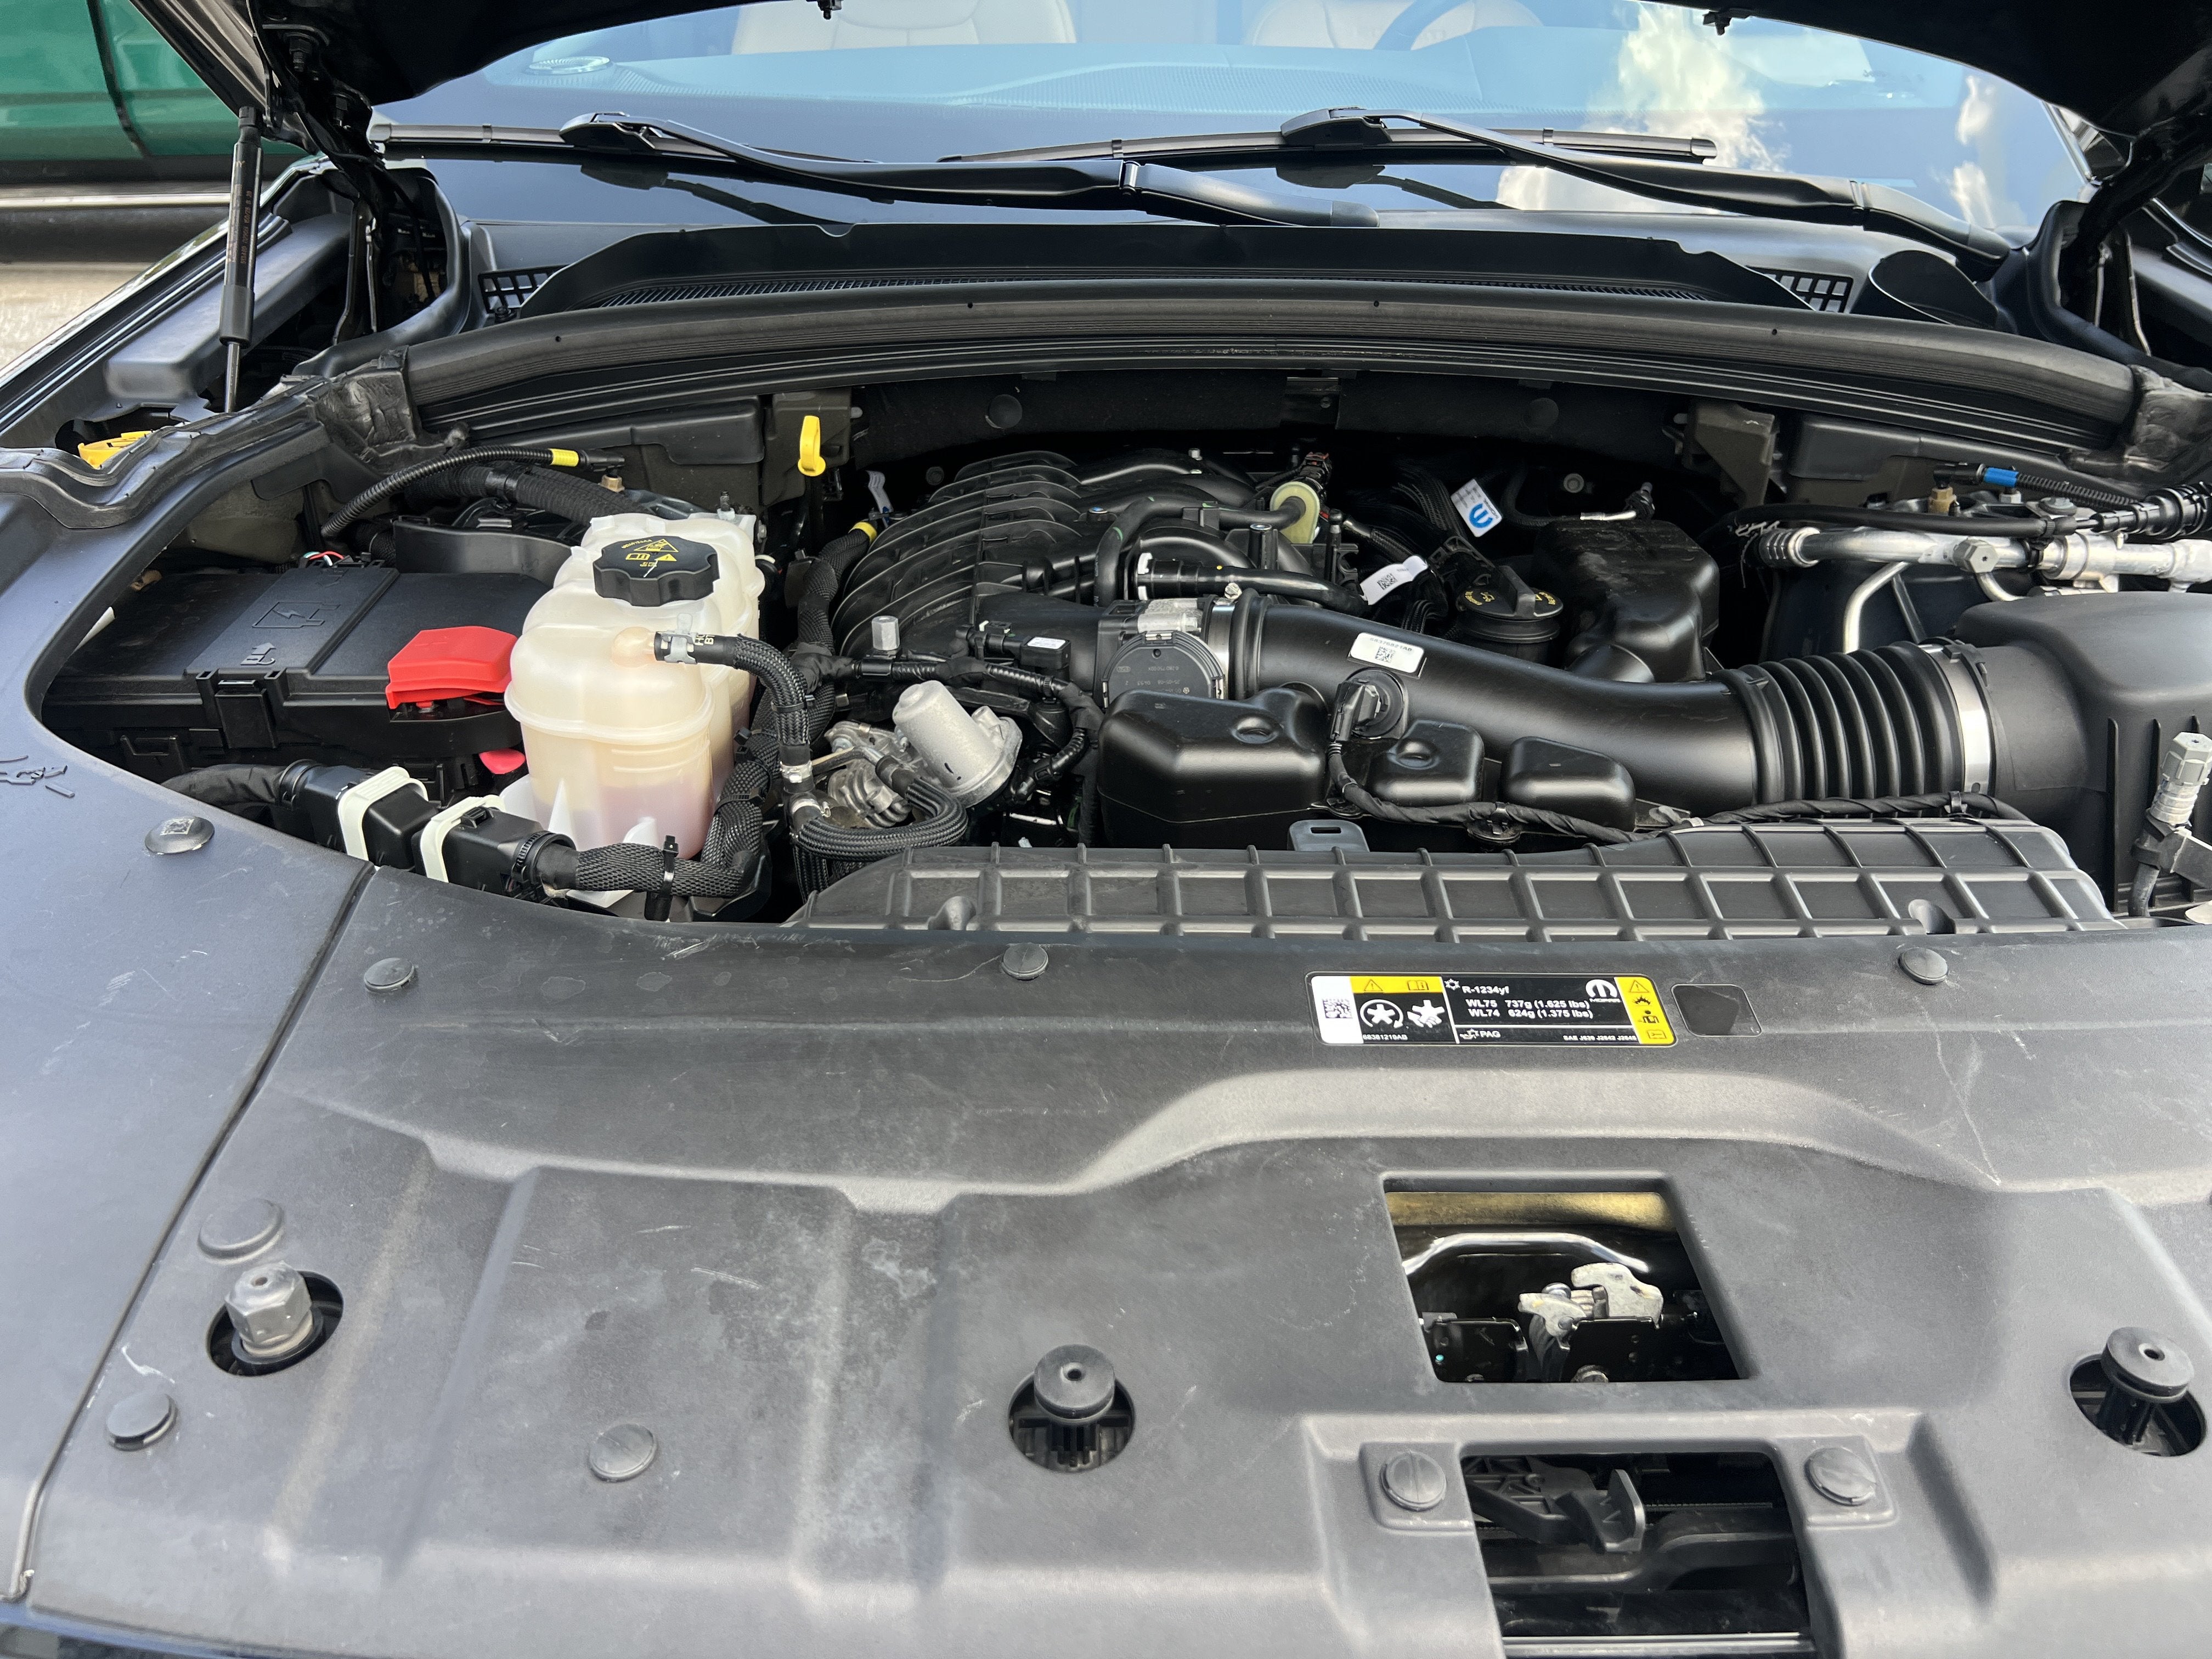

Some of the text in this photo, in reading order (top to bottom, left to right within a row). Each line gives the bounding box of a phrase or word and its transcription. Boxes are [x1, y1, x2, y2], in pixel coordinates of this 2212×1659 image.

[1462, 986, 1509, 995] R-1234yf
[1465, 999, 1590, 1009] WL75 737g (1.625 lbs)
[1468, 1009, 1593, 1019] WL74 624g (1.375 lbs)
[1480, 1030, 1501, 1039] PAG
